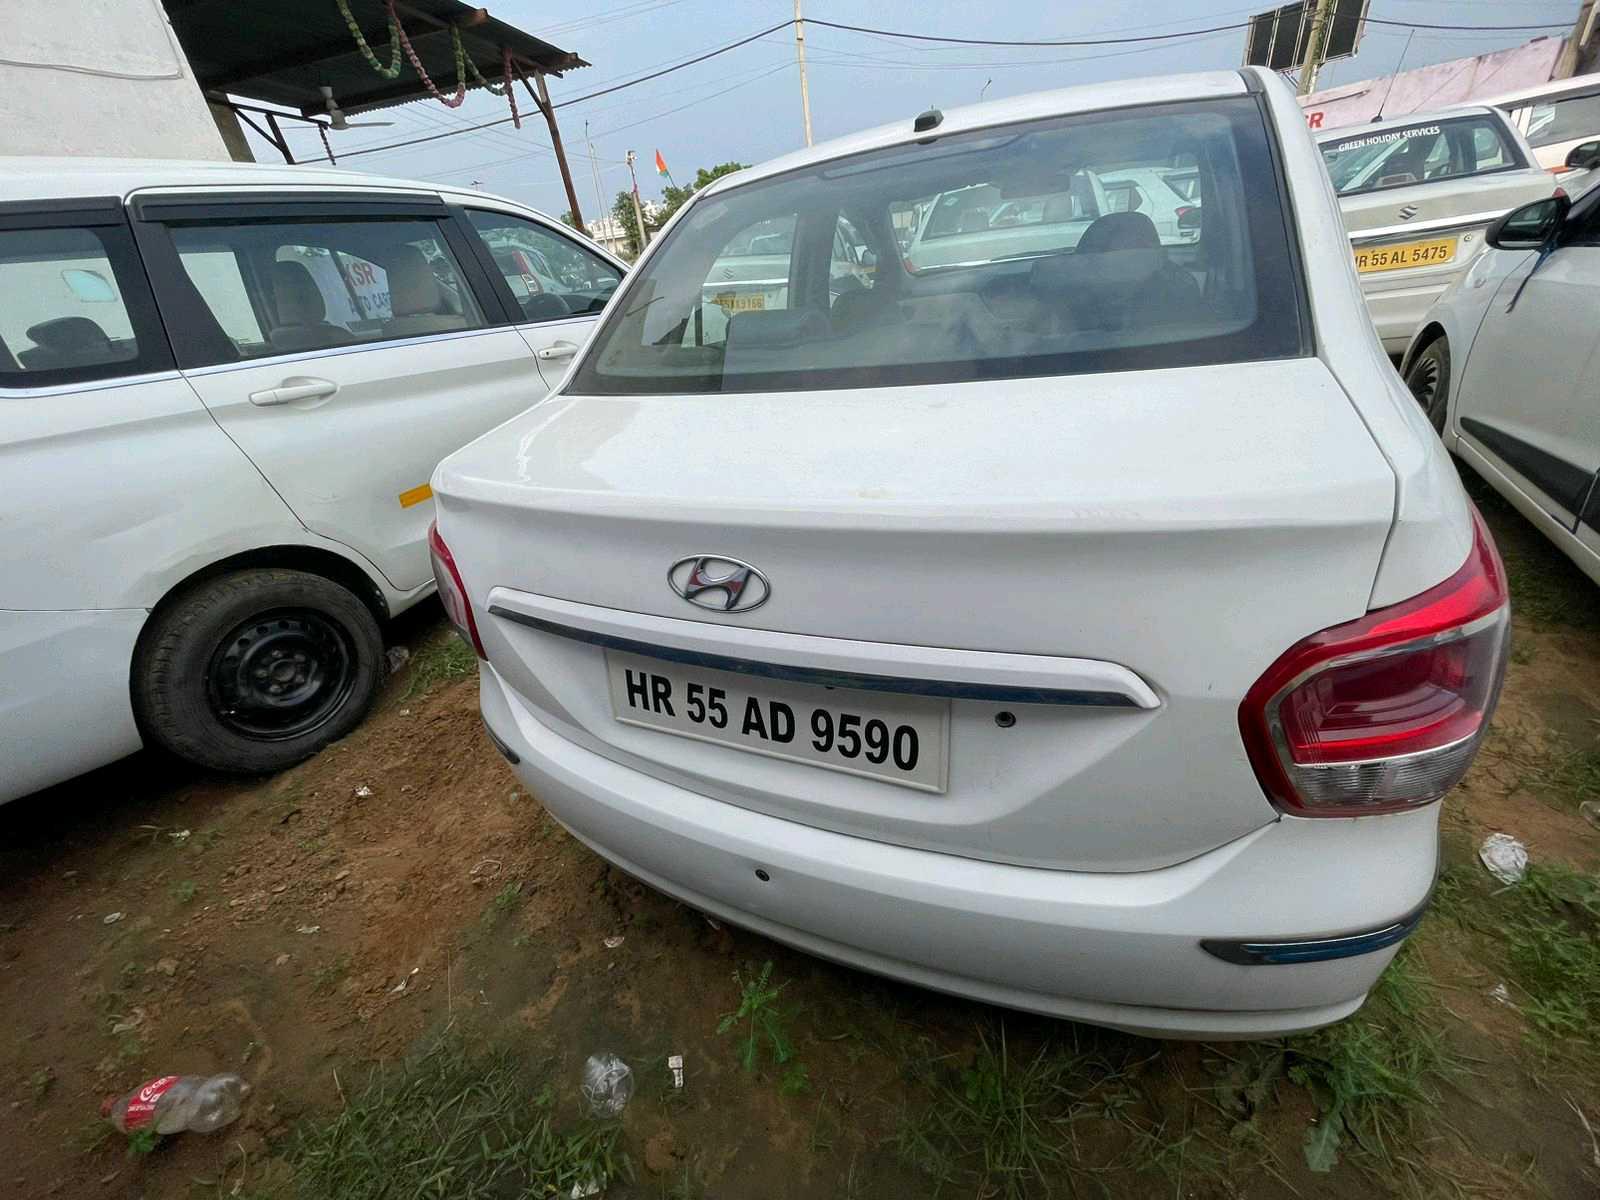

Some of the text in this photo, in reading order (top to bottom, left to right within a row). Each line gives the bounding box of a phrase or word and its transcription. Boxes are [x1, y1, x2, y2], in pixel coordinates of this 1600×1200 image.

[1338, 126, 1440, 152] GREEN HOLIDAY SERVICES
[1371, 252, 1388, 266] 55
[1390, 250, 1407, 264] AL
[1412, 245, 1448, 262] 5475
[624, 668, 920, 771] HR 55 AD 9590
